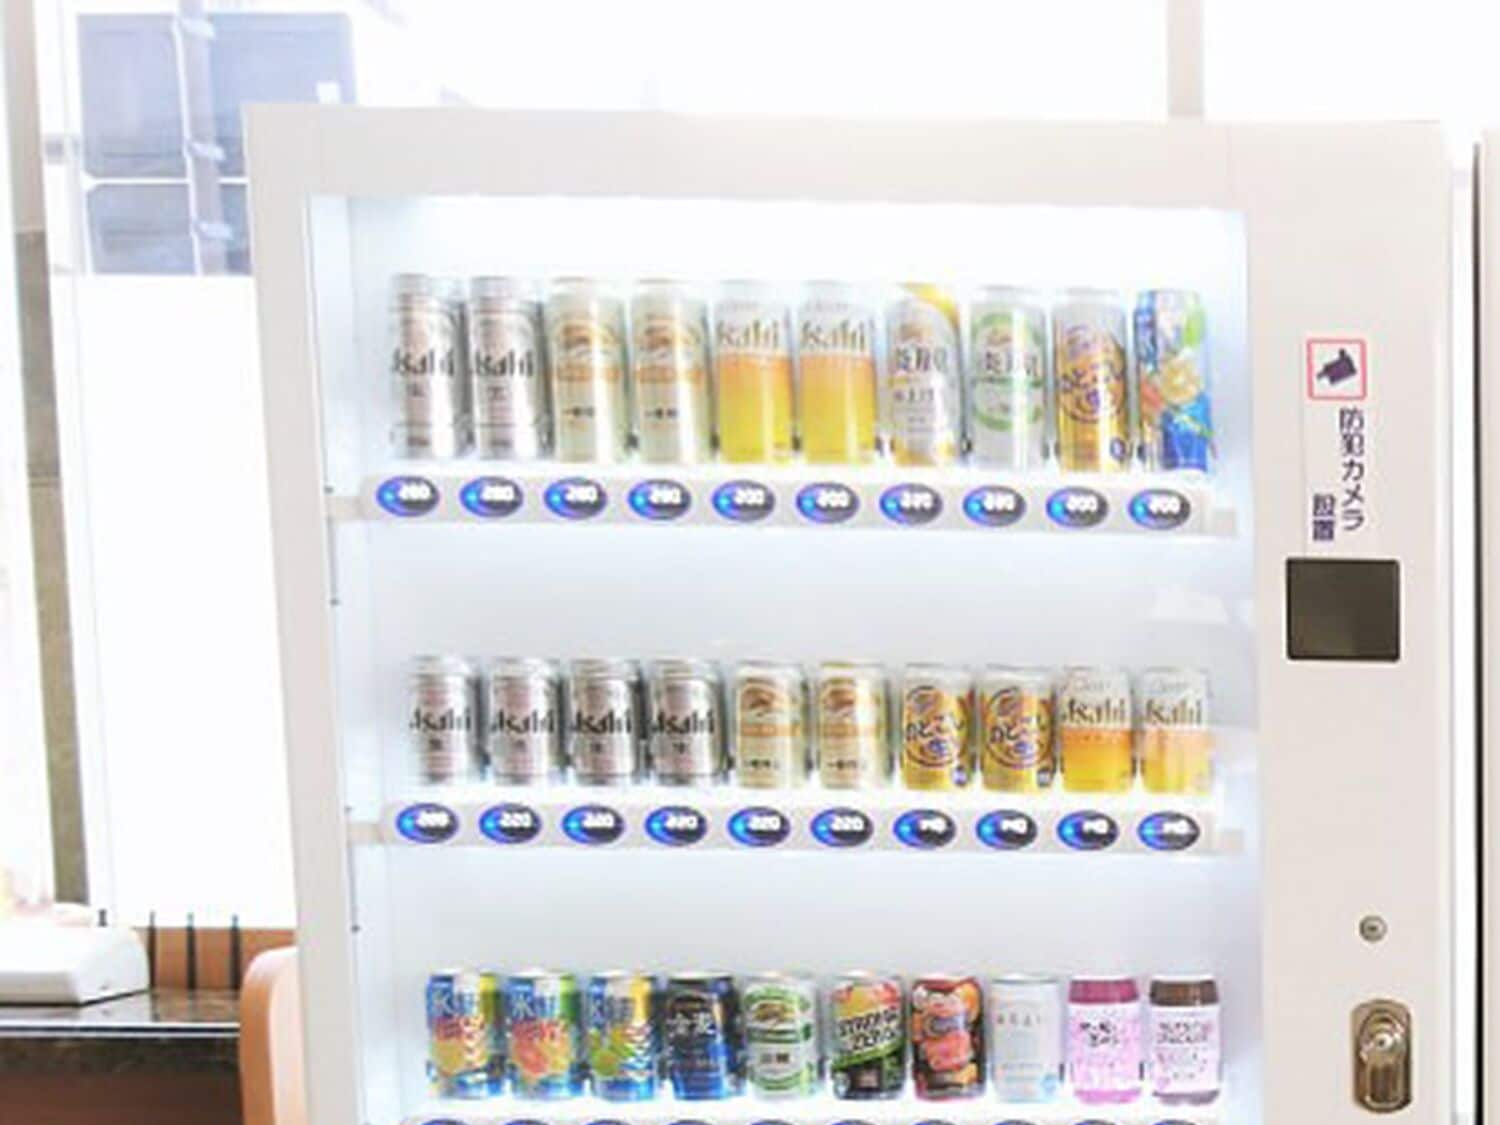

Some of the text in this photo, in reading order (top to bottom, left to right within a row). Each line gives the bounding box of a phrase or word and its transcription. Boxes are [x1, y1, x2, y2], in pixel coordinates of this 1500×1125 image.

[1339, 407, 1365, 531] 防犯カメラ
[1312, 493, 1336, 542] 設置
[491, 709, 556, 735] Asahi
[569, 709, 634, 736] Asahi
[650, 709, 715, 736] Asahi
